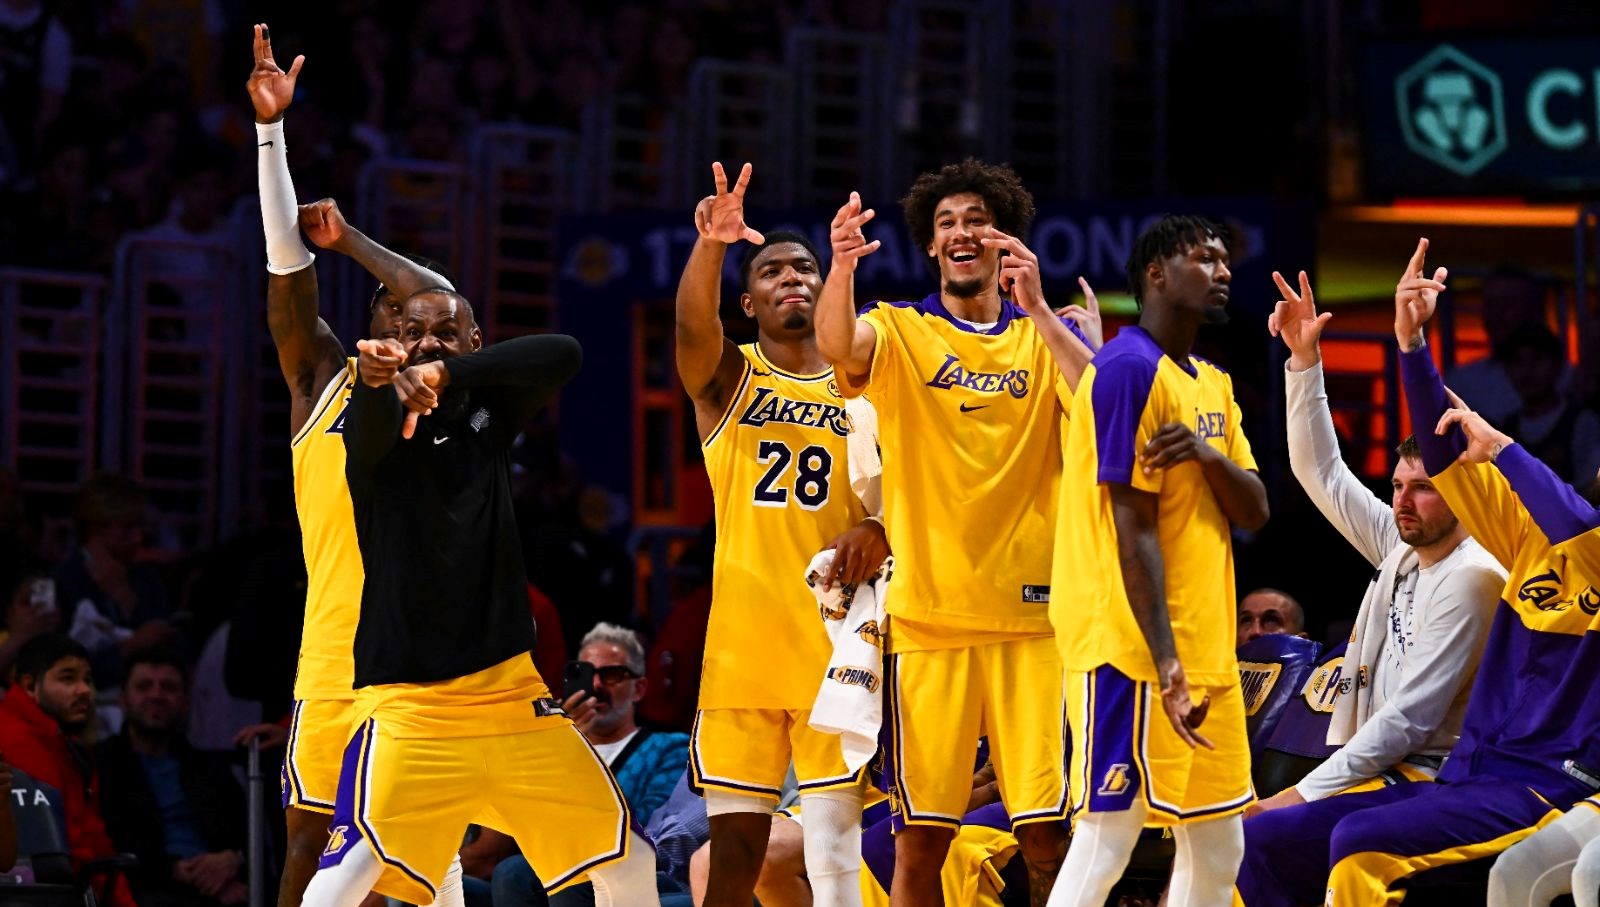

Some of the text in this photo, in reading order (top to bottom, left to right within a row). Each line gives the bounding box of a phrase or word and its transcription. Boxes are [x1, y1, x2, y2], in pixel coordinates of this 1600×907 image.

[1527, 68, 1600, 147] C
[926, 353, 1029, 399] LAKERS
[738, 386, 849, 437] LAKERS
[752, 440, 832, 511] 28
[842, 668, 875, 689] PRIME
